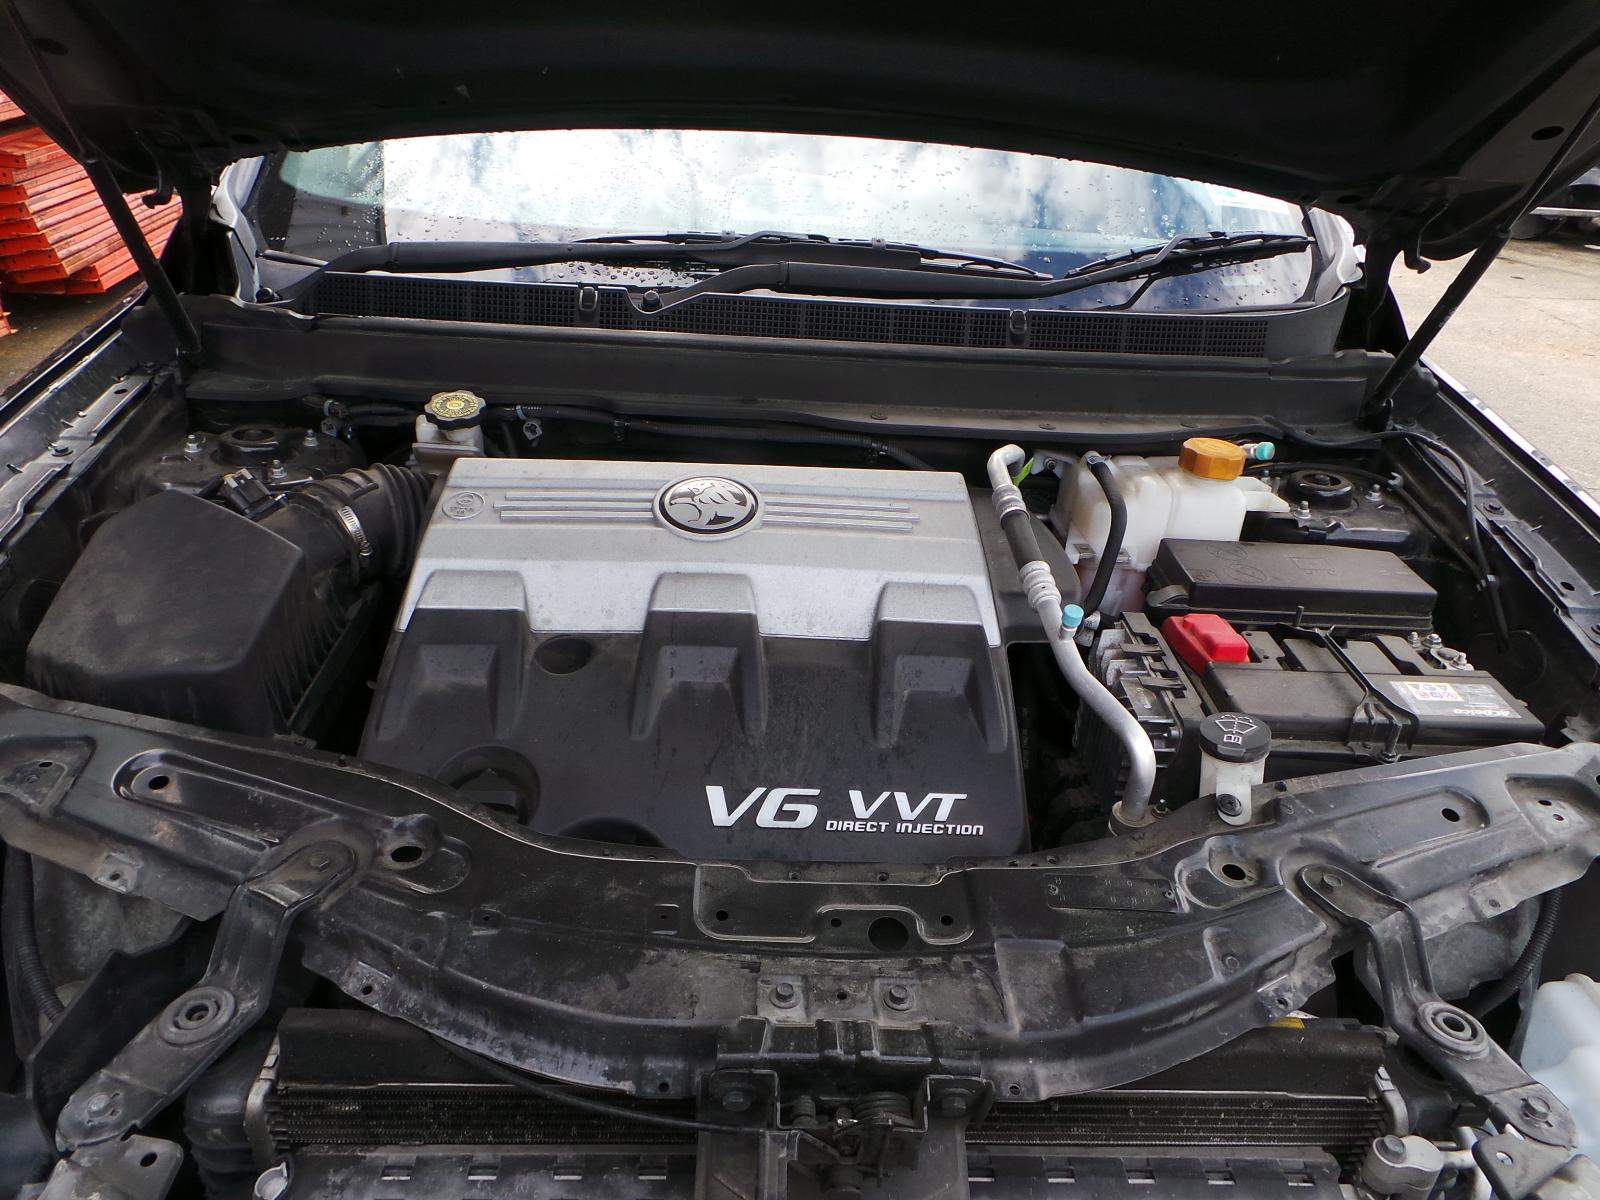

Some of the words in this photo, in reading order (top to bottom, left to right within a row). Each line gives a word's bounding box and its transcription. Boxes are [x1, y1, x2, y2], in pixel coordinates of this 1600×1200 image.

[705, 785, 821, 829] V6
[849, 790, 968, 822] VVT
[825, 820, 890, 833] DIRECT
[895, 823, 985, 836] INJECTION
